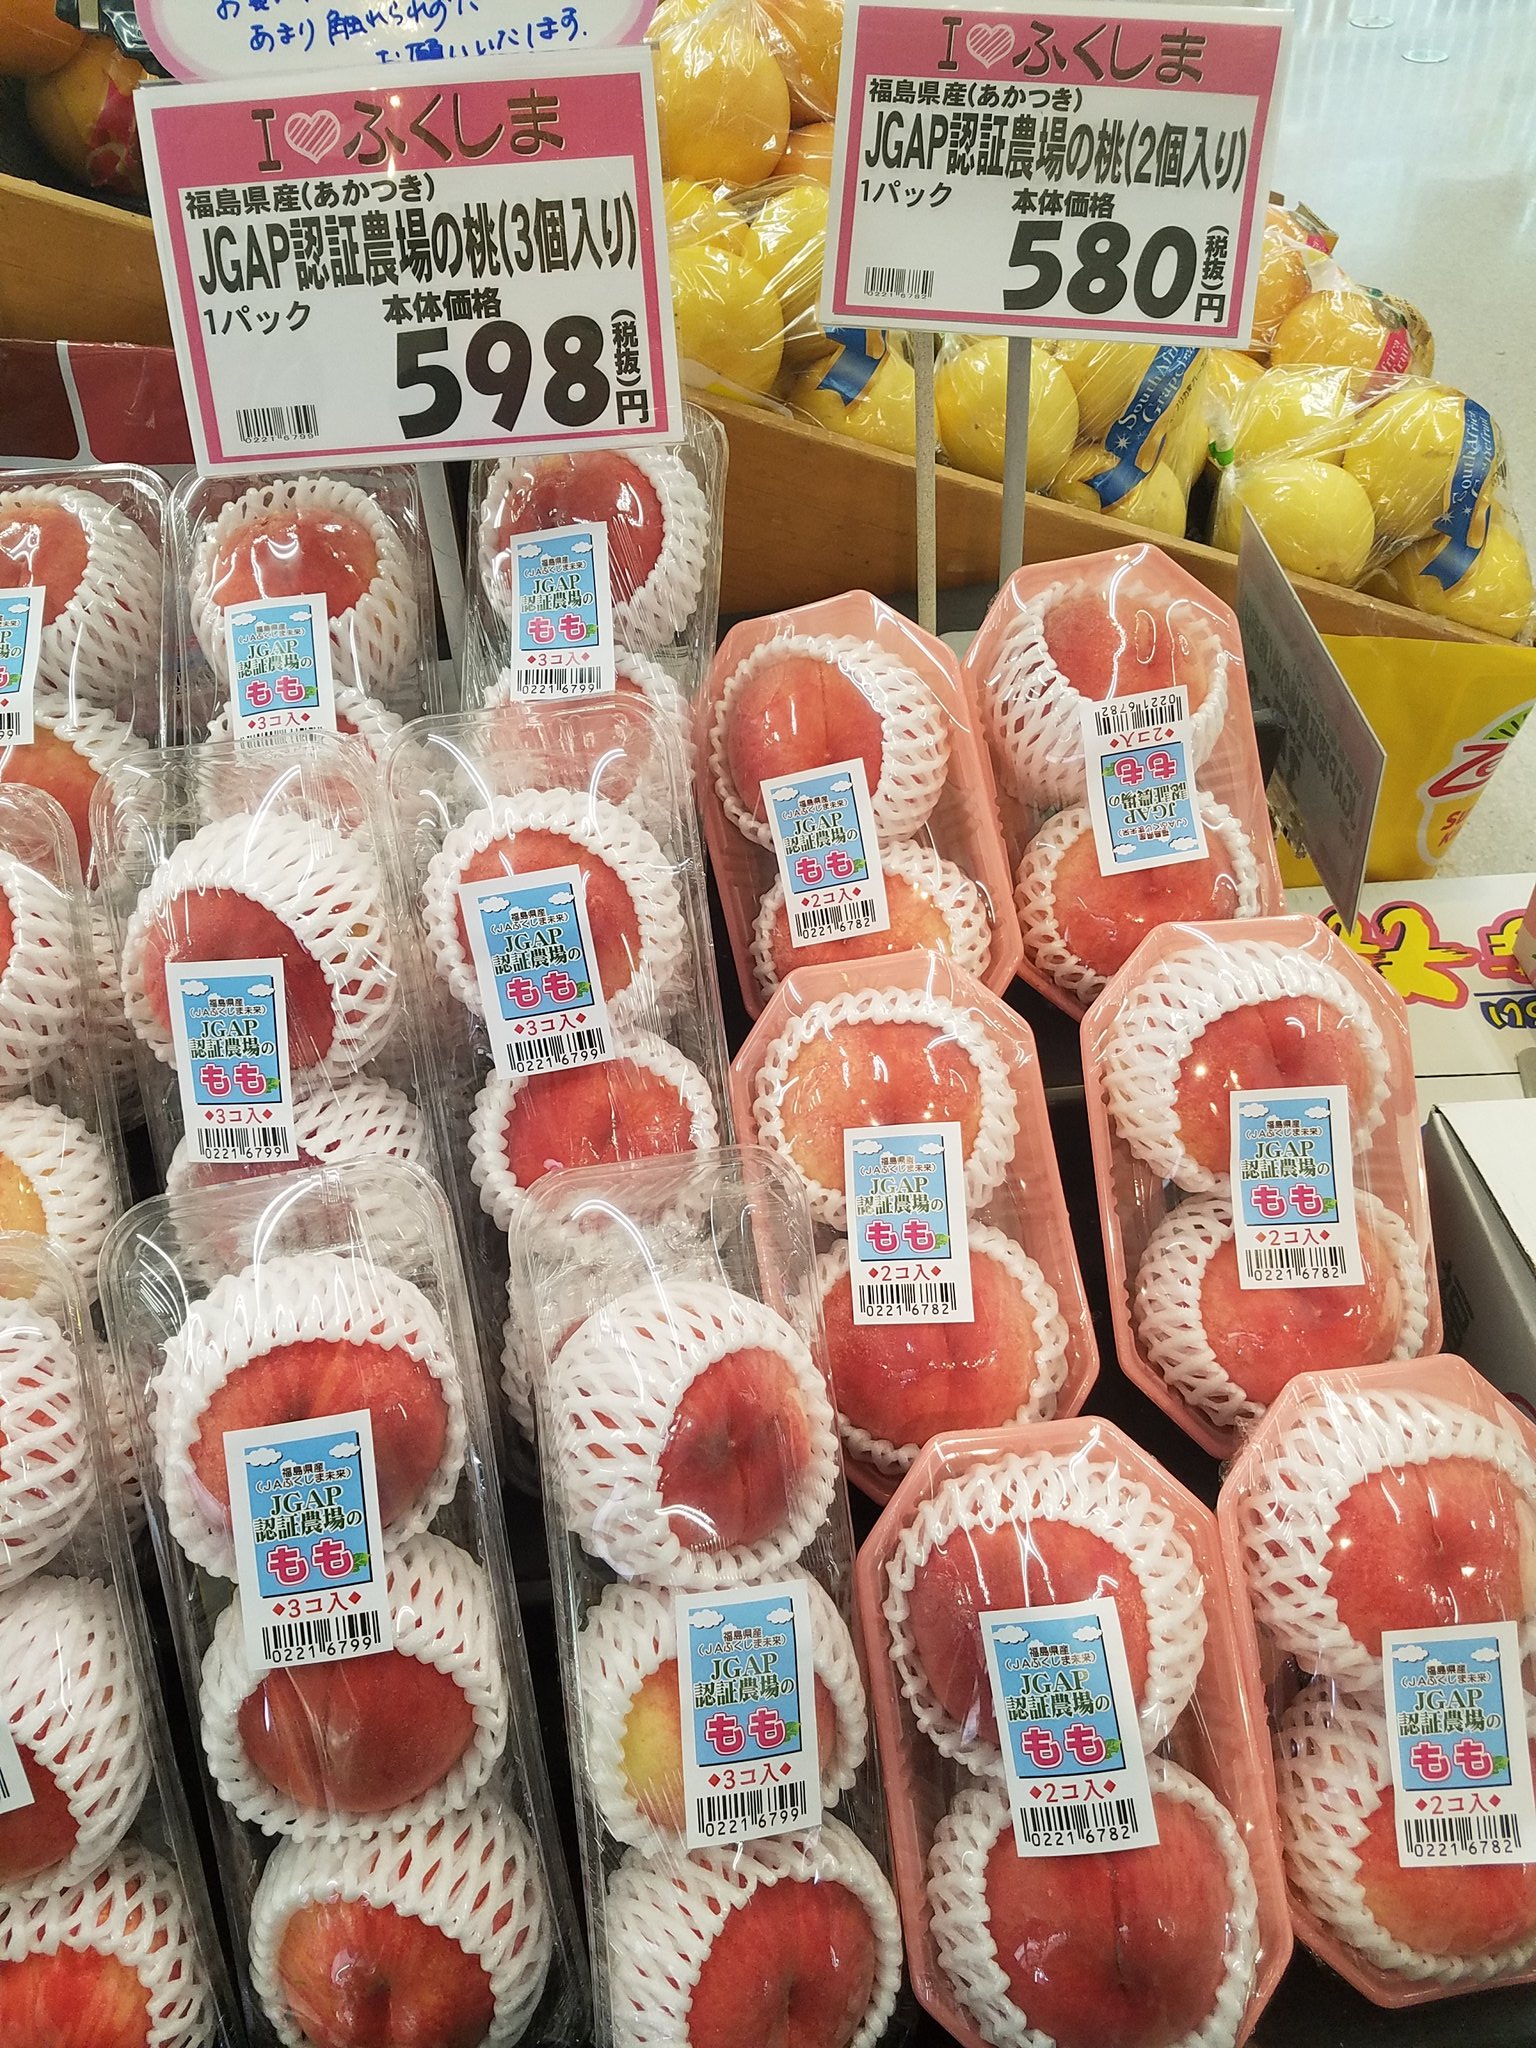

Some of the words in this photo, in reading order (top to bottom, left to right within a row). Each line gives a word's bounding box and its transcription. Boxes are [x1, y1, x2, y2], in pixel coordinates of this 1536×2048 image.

[939, 17, 962, 69] I
[1013, 21, 1206, 83] ふくしま
[869, 80, 1082, 112] 福島県産(あかつき)
[252, 108, 283, 171] I
[343, 88, 564, 165] ふくしま
[865, 110, 1247, 192] JGAP認証農場の桃(2個入り)
[184, 172, 435, 218] 福島県産(あかつき)
[861, 180, 952, 208] 1パック
[1011, 189, 1115, 219] 本体価格
[198, 192, 636, 294] JGAP認証農場の桃(3個入り)
[1003, 220, 1197, 318] 580
[1195, 292, 1226, 323] 円
[204, 301, 312, 335] 1パック
[383, 289, 501, 323] 本体価格
[396, 315, 611, 440] 598
[616, 389, 649, 425] 円
[534, 574, 580, 594] JGAP
[521, 590, 593, 612] 認証農場の
[529, 614, 586, 642] もも
[248, 640, 297, 660] JGAP
[538, 652, 580, 667] 3コ入
[246, 676, 304, 706] もも
[258, 712, 300, 729] 3コ入
[1120, 728, 1163, 747] 2コ入
[1115, 752, 1176, 785] もも
[1109, 782, 1187, 809] 認証農場の
[794, 813, 842, 835] JGAP
[1125, 803, 1176, 823] JGAP
[784, 828, 857, 855] 認証農場の
[797, 851, 854, 883] もも
[811, 889, 853, 908] 2コ入
[511, 909, 545, 921] 福島県産
[505, 928, 563, 952] JGAP
[493, 946, 580, 974] 認証農場の
[507, 971, 577, 1008] もも
[209, 999, 243, 1007] 福島県産
[202, 1020, 258, 1038] JGAP
[527, 1014, 575, 1035] 3コ入
[191, 1038, 274, 1058] 認証農場の
[201, 1063, 266, 1096] もも
[216, 1108, 262, 1124] 3コ入
[1256, 1141, 1314, 1158] JGAP
[1242, 1158, 1330, 1180] 認証農場の
[871, 1177, 928, 1194] JGAP
[858, 1194, 944, 1215] 認証農場の
[1252, 1185, 1323, 1218] もも
[867, 1220, 936, 1253] もも
[1269, 1229, 1319, 1245] 2コ入
[882, 1265, 930, 1281] 2コ入
[282, 1462, 324, 1478] 福島県産
[272, 1486, 342, 1515] JGAP
[254, 1509, 361, 1542] 認証農場の
[267, 1538, 353, 1585] もも
[288, 1592, 348, 1618] 3コ入
[723, 1628, 761, 1642] 福島県産
[1029, 1646, 1069, 1657] 福島県産
[712, 1653, 777, 1680] JGAP
[1427, 1665, 1465, 1675] 福島県産
[694, 1675, 794, 1708] 認証農場の
[1022, 1670, 1088, 1694] JGAP
[1007, 1692, 1110, 1720] 認証農場の
[1415, 1689, 1482, 1710] JGAP
[706, 1707, 786, 1754] もも
[1399, 1711, 1501, 1735] 認証農場の
[1022, 1724, 1106, 1768] もも
[1411, 1739, 1493, 1781] もも
[724, 1763, 779, 1789] 3コ入
[1044, 1779, 1104, 1802] 2コ入
[1430, 1794, 1488, 1814] 2コ入
